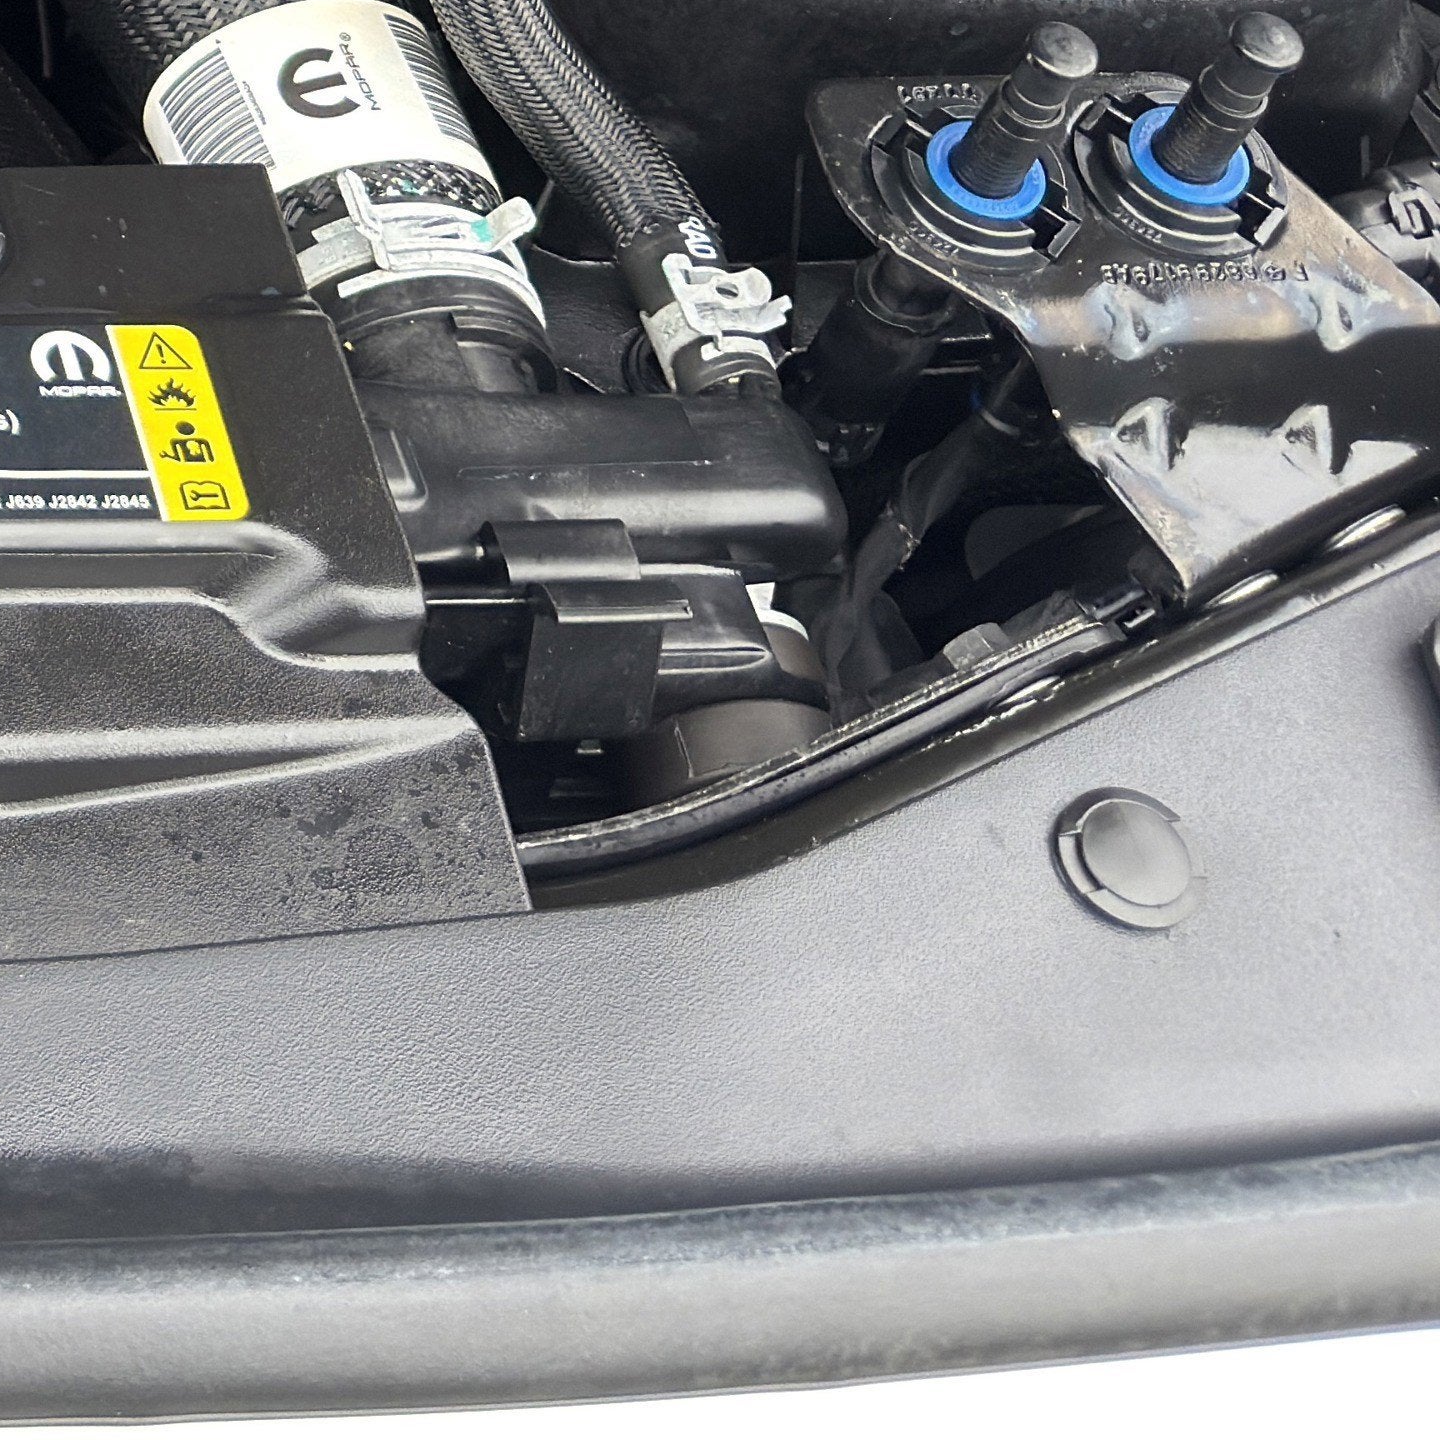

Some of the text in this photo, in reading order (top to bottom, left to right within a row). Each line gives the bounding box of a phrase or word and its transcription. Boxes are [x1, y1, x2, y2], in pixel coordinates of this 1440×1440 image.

[678, 216, 717, 258] RAD
[5, 494, 46, 510] J639
[48, 494, 98, 510] J2842
[100, 494, 151, 510] J2845
